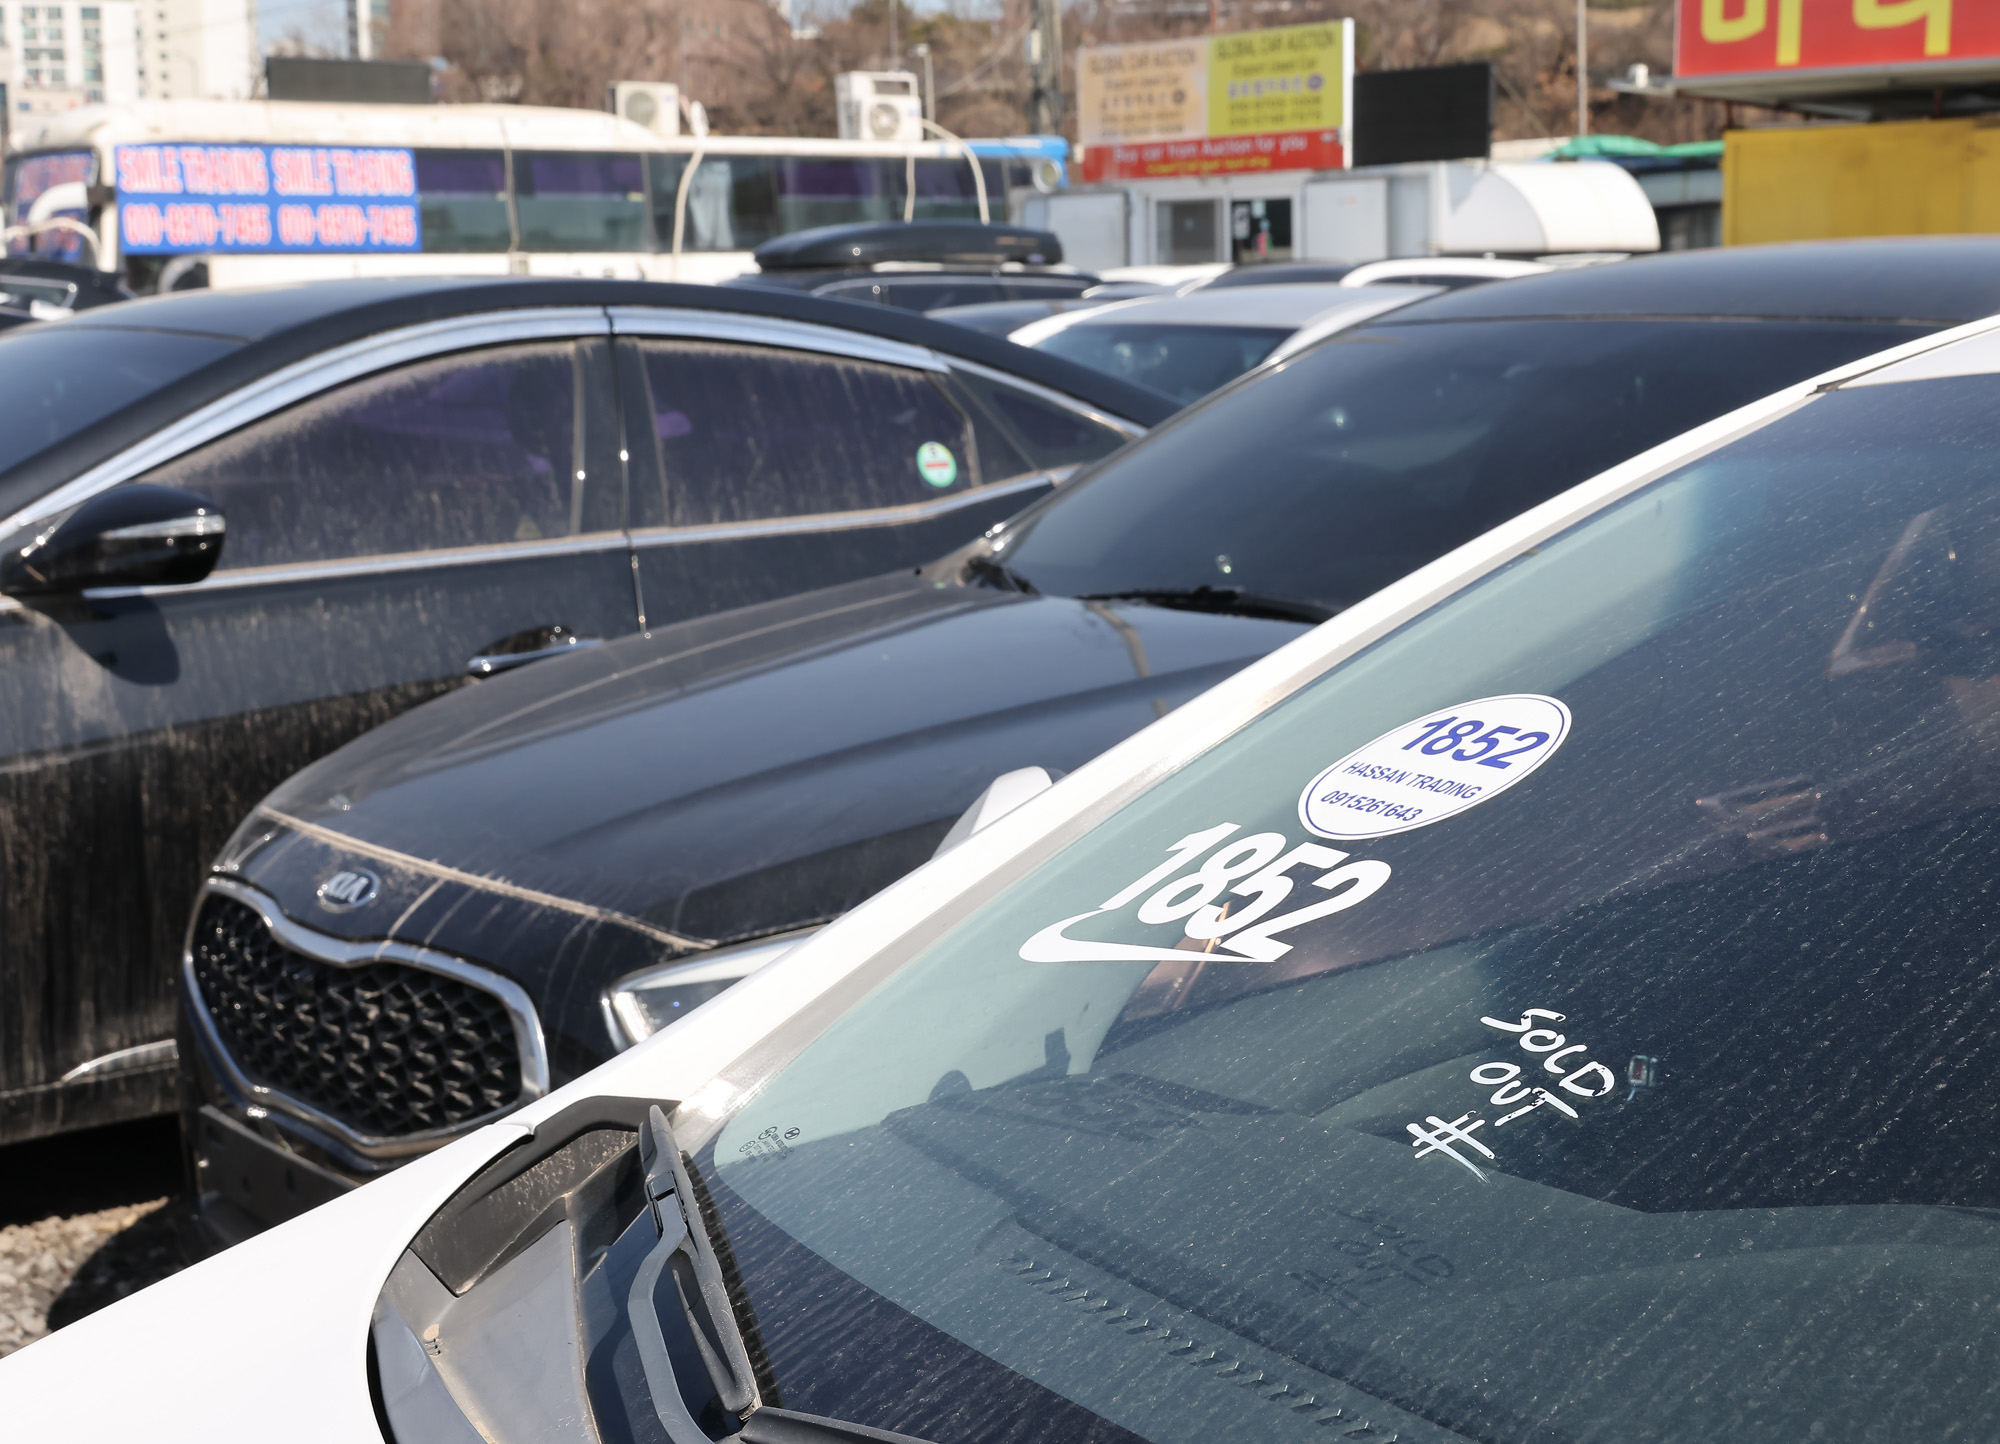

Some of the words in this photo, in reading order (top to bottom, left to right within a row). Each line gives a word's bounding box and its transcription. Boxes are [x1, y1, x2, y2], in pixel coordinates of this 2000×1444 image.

[1202, 139, 1253, 156] Auction
[1281, 135, 1307, 155] you
[1402, 716, 1550, 769] 1852
[1320, 790, 1423, 821] 0915261643
[1342, 761, 1411, 784] HASSAN
[1408, 774, 1482, 800] TRADING
[1099, 822, 1392, 962] 1852
[1480, 1008, 1615, 1097] SOLD
[1470, 1062, 1578, 1126] OUT
